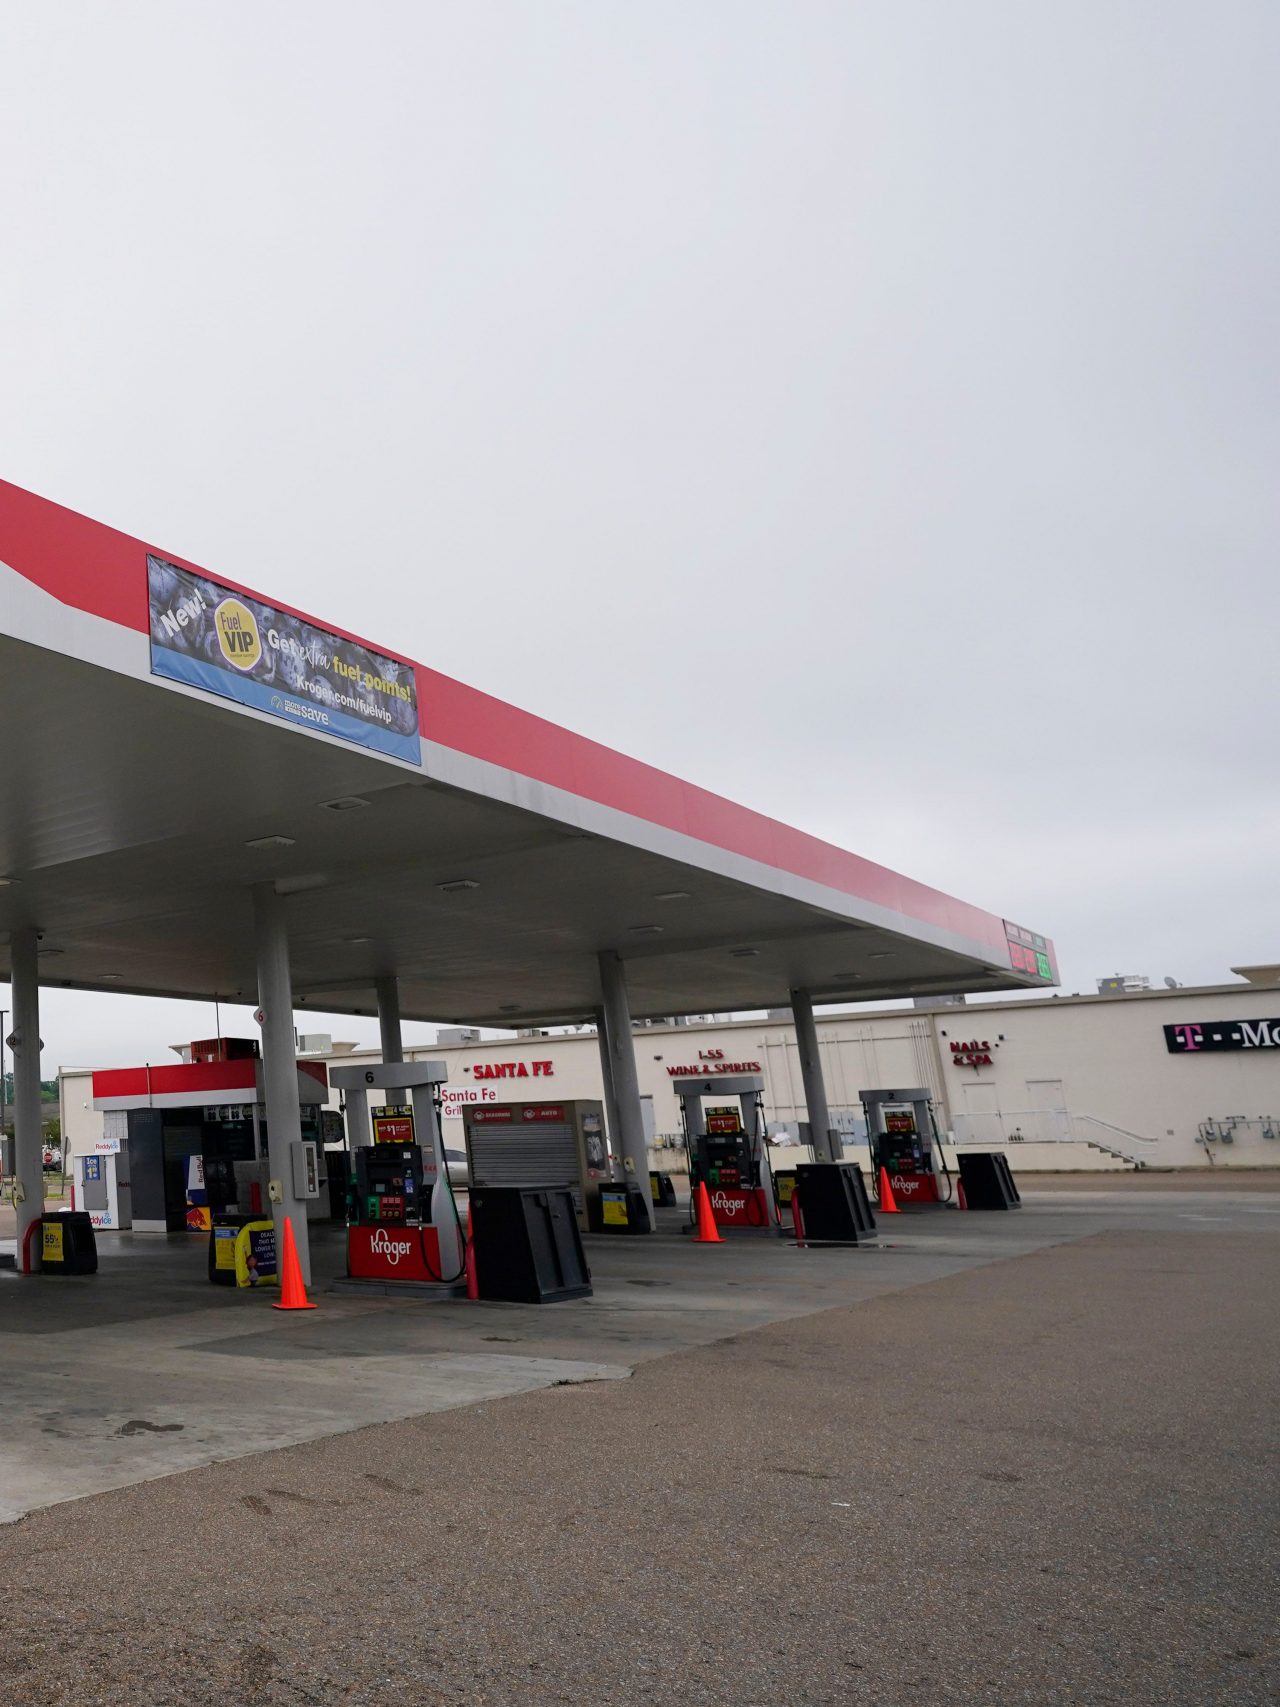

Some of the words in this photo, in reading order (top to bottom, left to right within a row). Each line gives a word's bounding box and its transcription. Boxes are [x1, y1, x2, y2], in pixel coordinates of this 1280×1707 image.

[160, 588, 207, 637] New!
[220, 612, 242, 631] Fuel
[224, 631, 254, 652] VIP
[268, 629, 299, 656] Get
[299, 640, 331, 669] extra
[332, 656, 361, 682] fuel
[364, 673, 411, 703] points!
[296, 676, 392, 724] Kroger.com/fuelvip
[300, 705, 329, 725] save
[258, 1010, 264, 1022] 6
[950, 1041, 990, 1052] NAILS
[365, 1071, 375, 1083] 6
[473, 1063, 528, 1079] SANTA
[531, 1060, 554, 1076] FE
[667, 1065, 700, 1076] WINE
[703, 1064, 711, 1074] &
[714, 1062, 762, 1073] SPIRITS
[441, 1089, 477, 1102] Santa
[481, 1087, 497, 1101] Fe
[704, 1083, 712, 1092] 4
[888, 1092, 895, 1100] 2
[891, 1175, 919, 1194] Kroger
[711, 1191, 746, 1216] Kroger
[370, 1228, 412, 1265] Kroger
